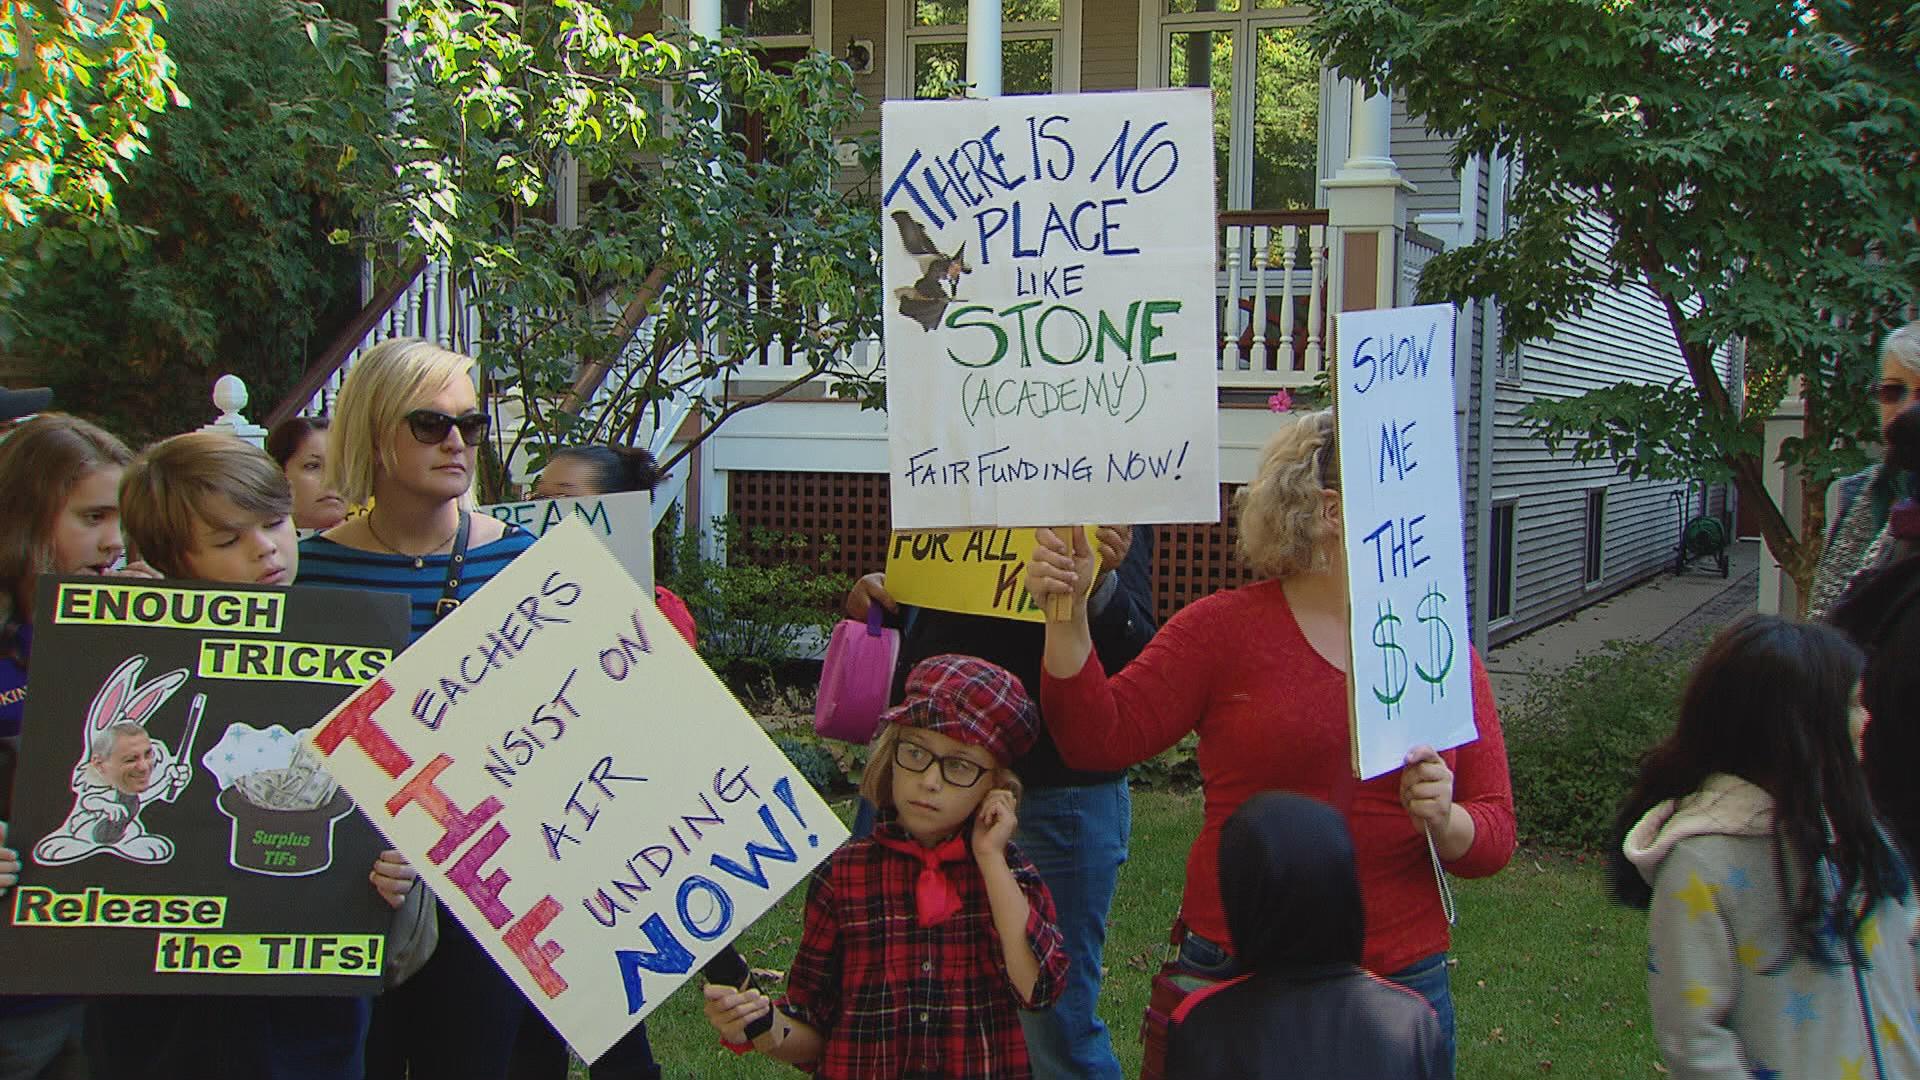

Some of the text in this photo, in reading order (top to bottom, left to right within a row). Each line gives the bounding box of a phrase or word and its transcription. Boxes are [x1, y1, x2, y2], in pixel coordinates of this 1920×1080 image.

[884, 115, 1179, 230] THERE IS NO
[973, 198, 1140, 264] PLACE
[1016, 264, 1085, 298] LIKE
[944, 300, 1182, 368] STONE
[1353, 322, 1437, 394] SHOW
[961, 365, 1147, 427] (ACADEMY)
[905, 441, 1189, 487] FAIR FUNDING NOW!
[1379, 417, 1418, 483] ME
[893, 528, 1018, 563] FOR ALL
[1362, 513, 1432, 583] THE
[60, 588, 280, 628] ENOUGH
[205, 642, 385, 680] TRICKS
[598, 608, 652, 680] ON
[253, 829, 311, 848] Surplus
[264, 850, 297, 867] TIFs
[16, 888, 222, 924] Release
[615, 776, 820, 1016] NOW!
[161, 937, 379, 970] the TIFs!
